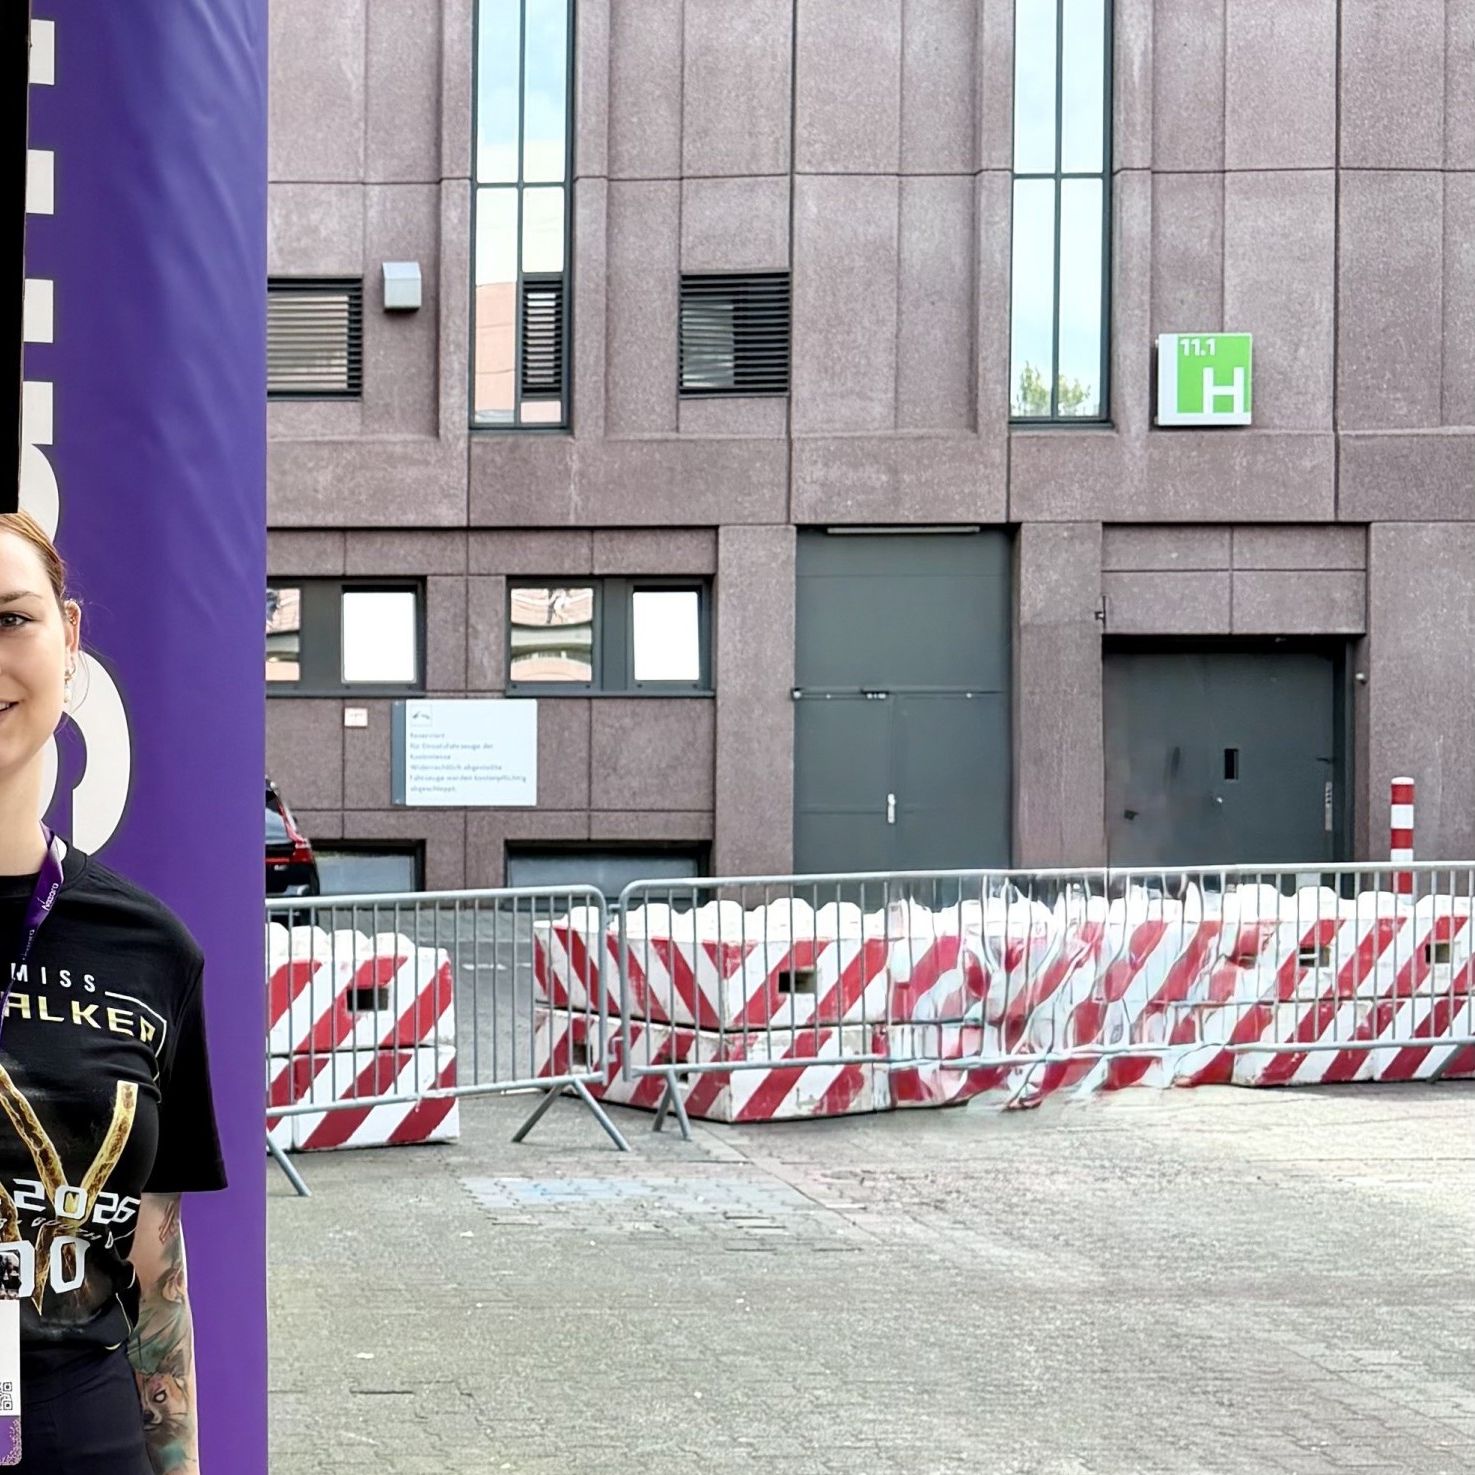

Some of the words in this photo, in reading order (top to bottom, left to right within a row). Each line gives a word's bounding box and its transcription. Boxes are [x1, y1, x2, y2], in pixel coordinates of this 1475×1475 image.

[1180, 338, 1216, 356] 11.1
[1203, 366, 1244, 413] H
[11, 963, 96, 992] MISS
